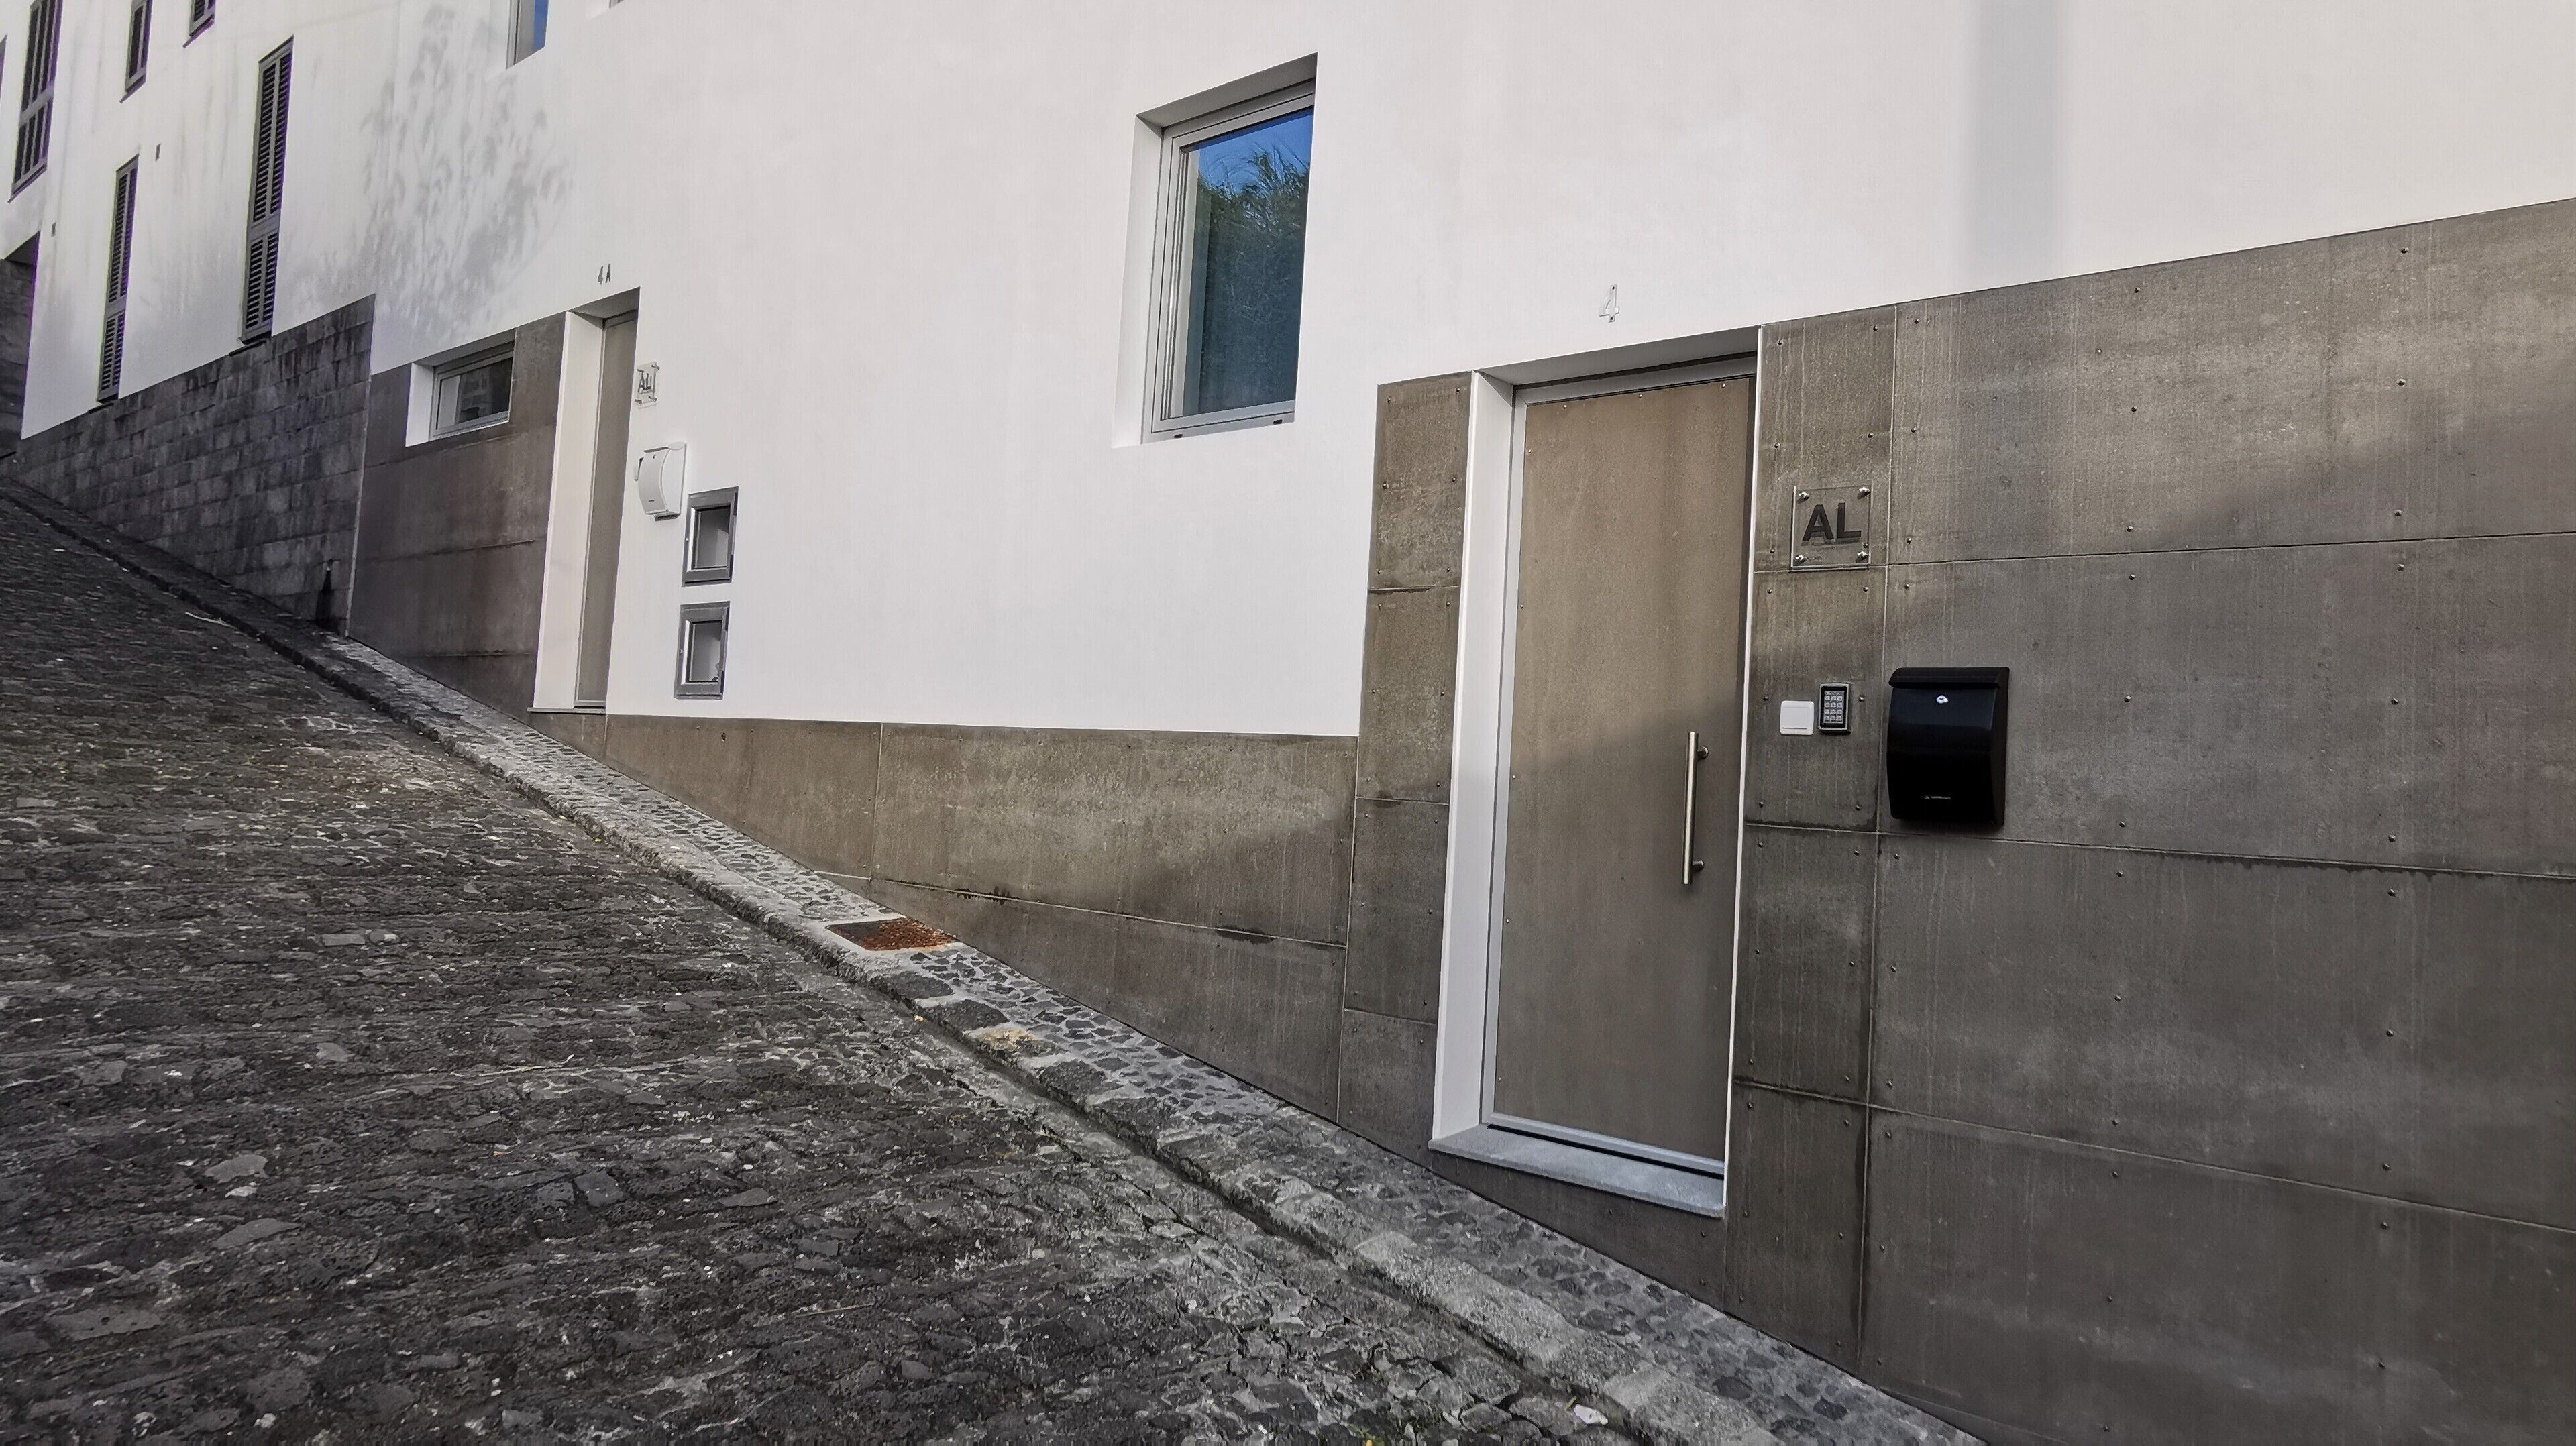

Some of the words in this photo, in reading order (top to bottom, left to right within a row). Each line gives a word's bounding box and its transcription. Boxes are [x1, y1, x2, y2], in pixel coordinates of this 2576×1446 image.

[1599, 284, 1620, 323] 4
[637, 373, 652, 394] AL
[1802, 502, 1862, 542] AL
